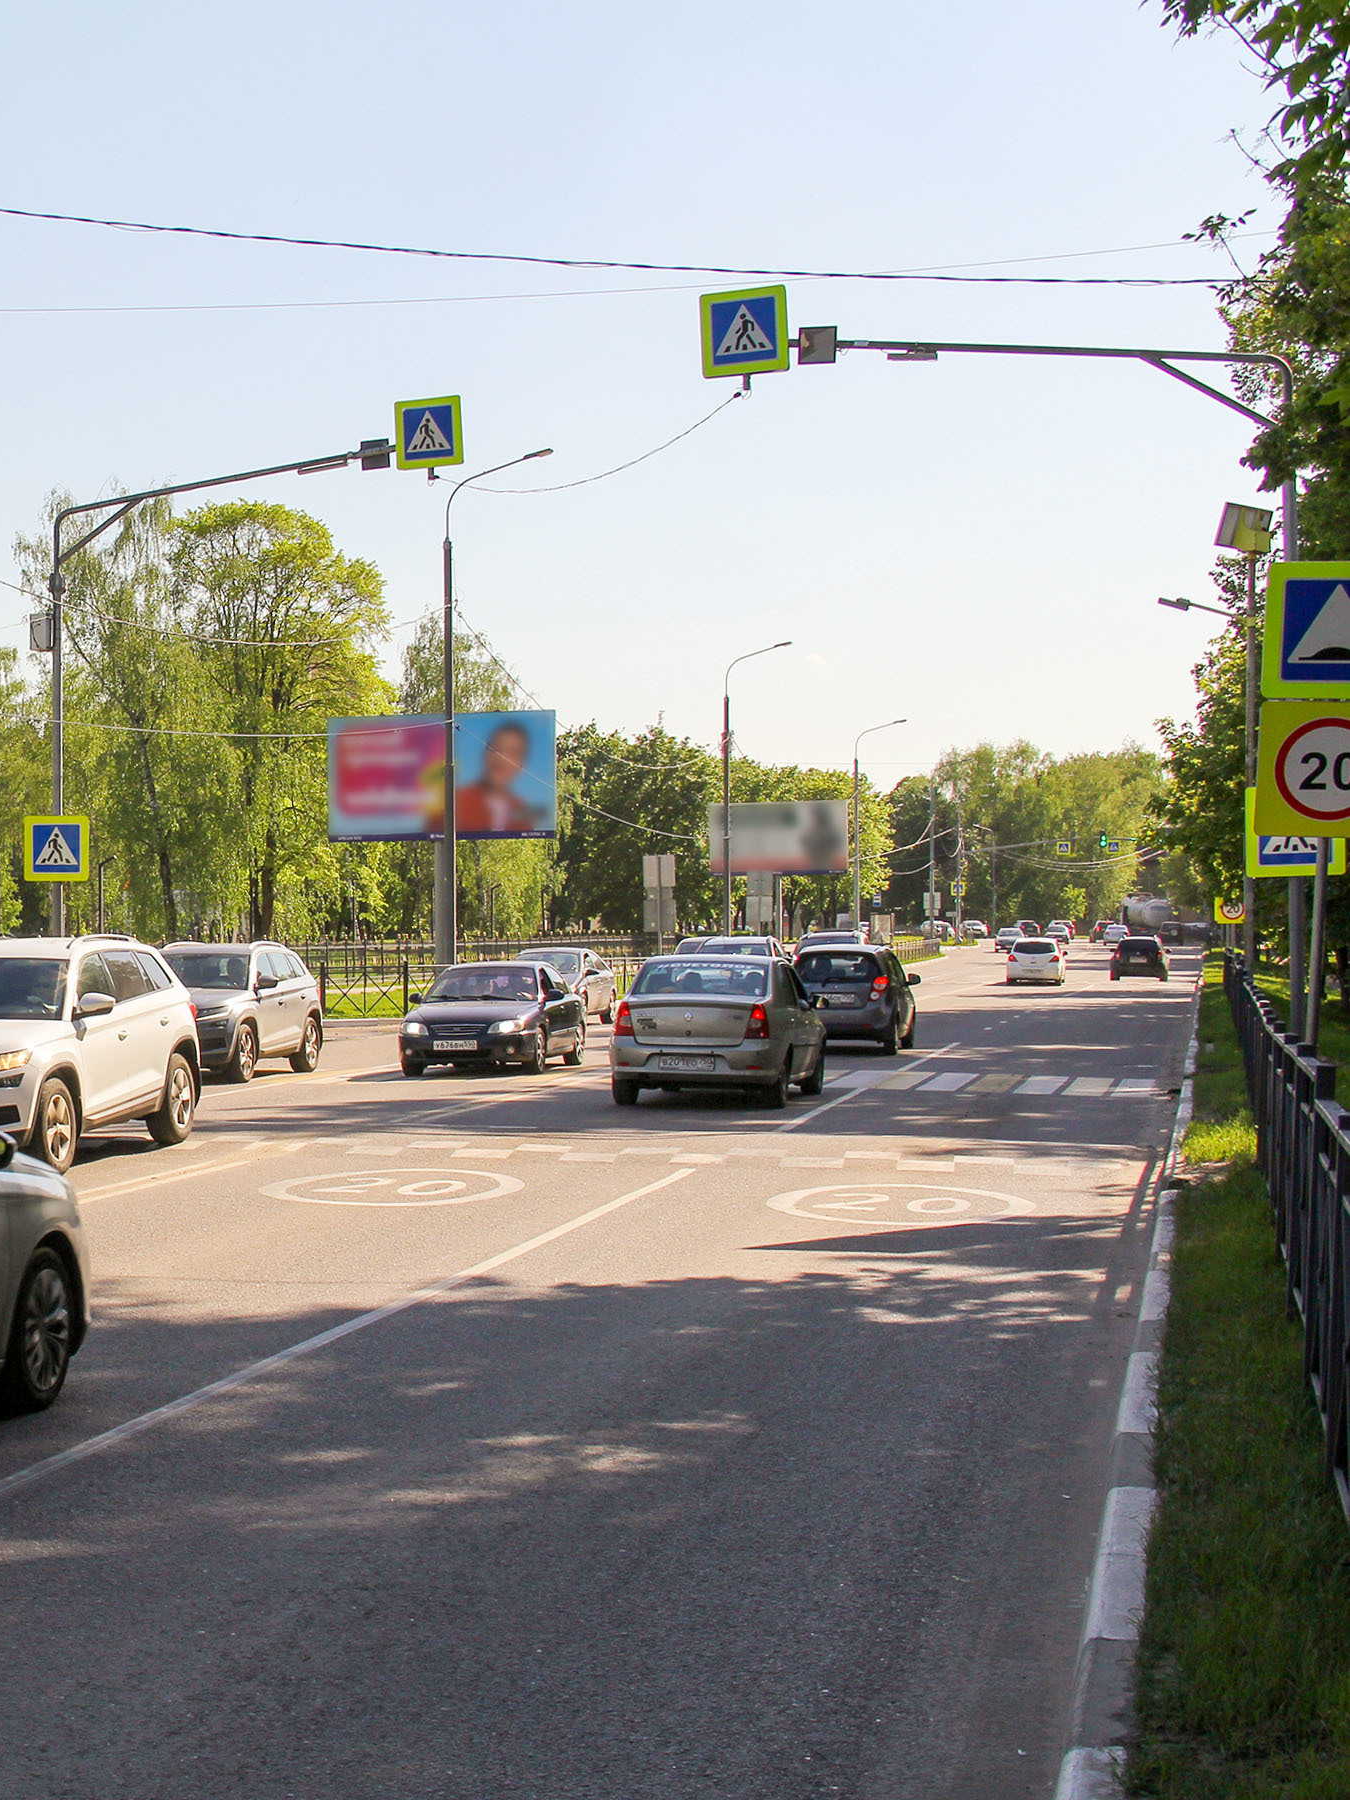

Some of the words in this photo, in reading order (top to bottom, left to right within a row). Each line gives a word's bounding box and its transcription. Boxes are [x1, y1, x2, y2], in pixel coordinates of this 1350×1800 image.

[1299, 751, 1350, 791] 20
[311, 1176, 467, 1196] 20
[812, 1192, 972, 1214] 20
